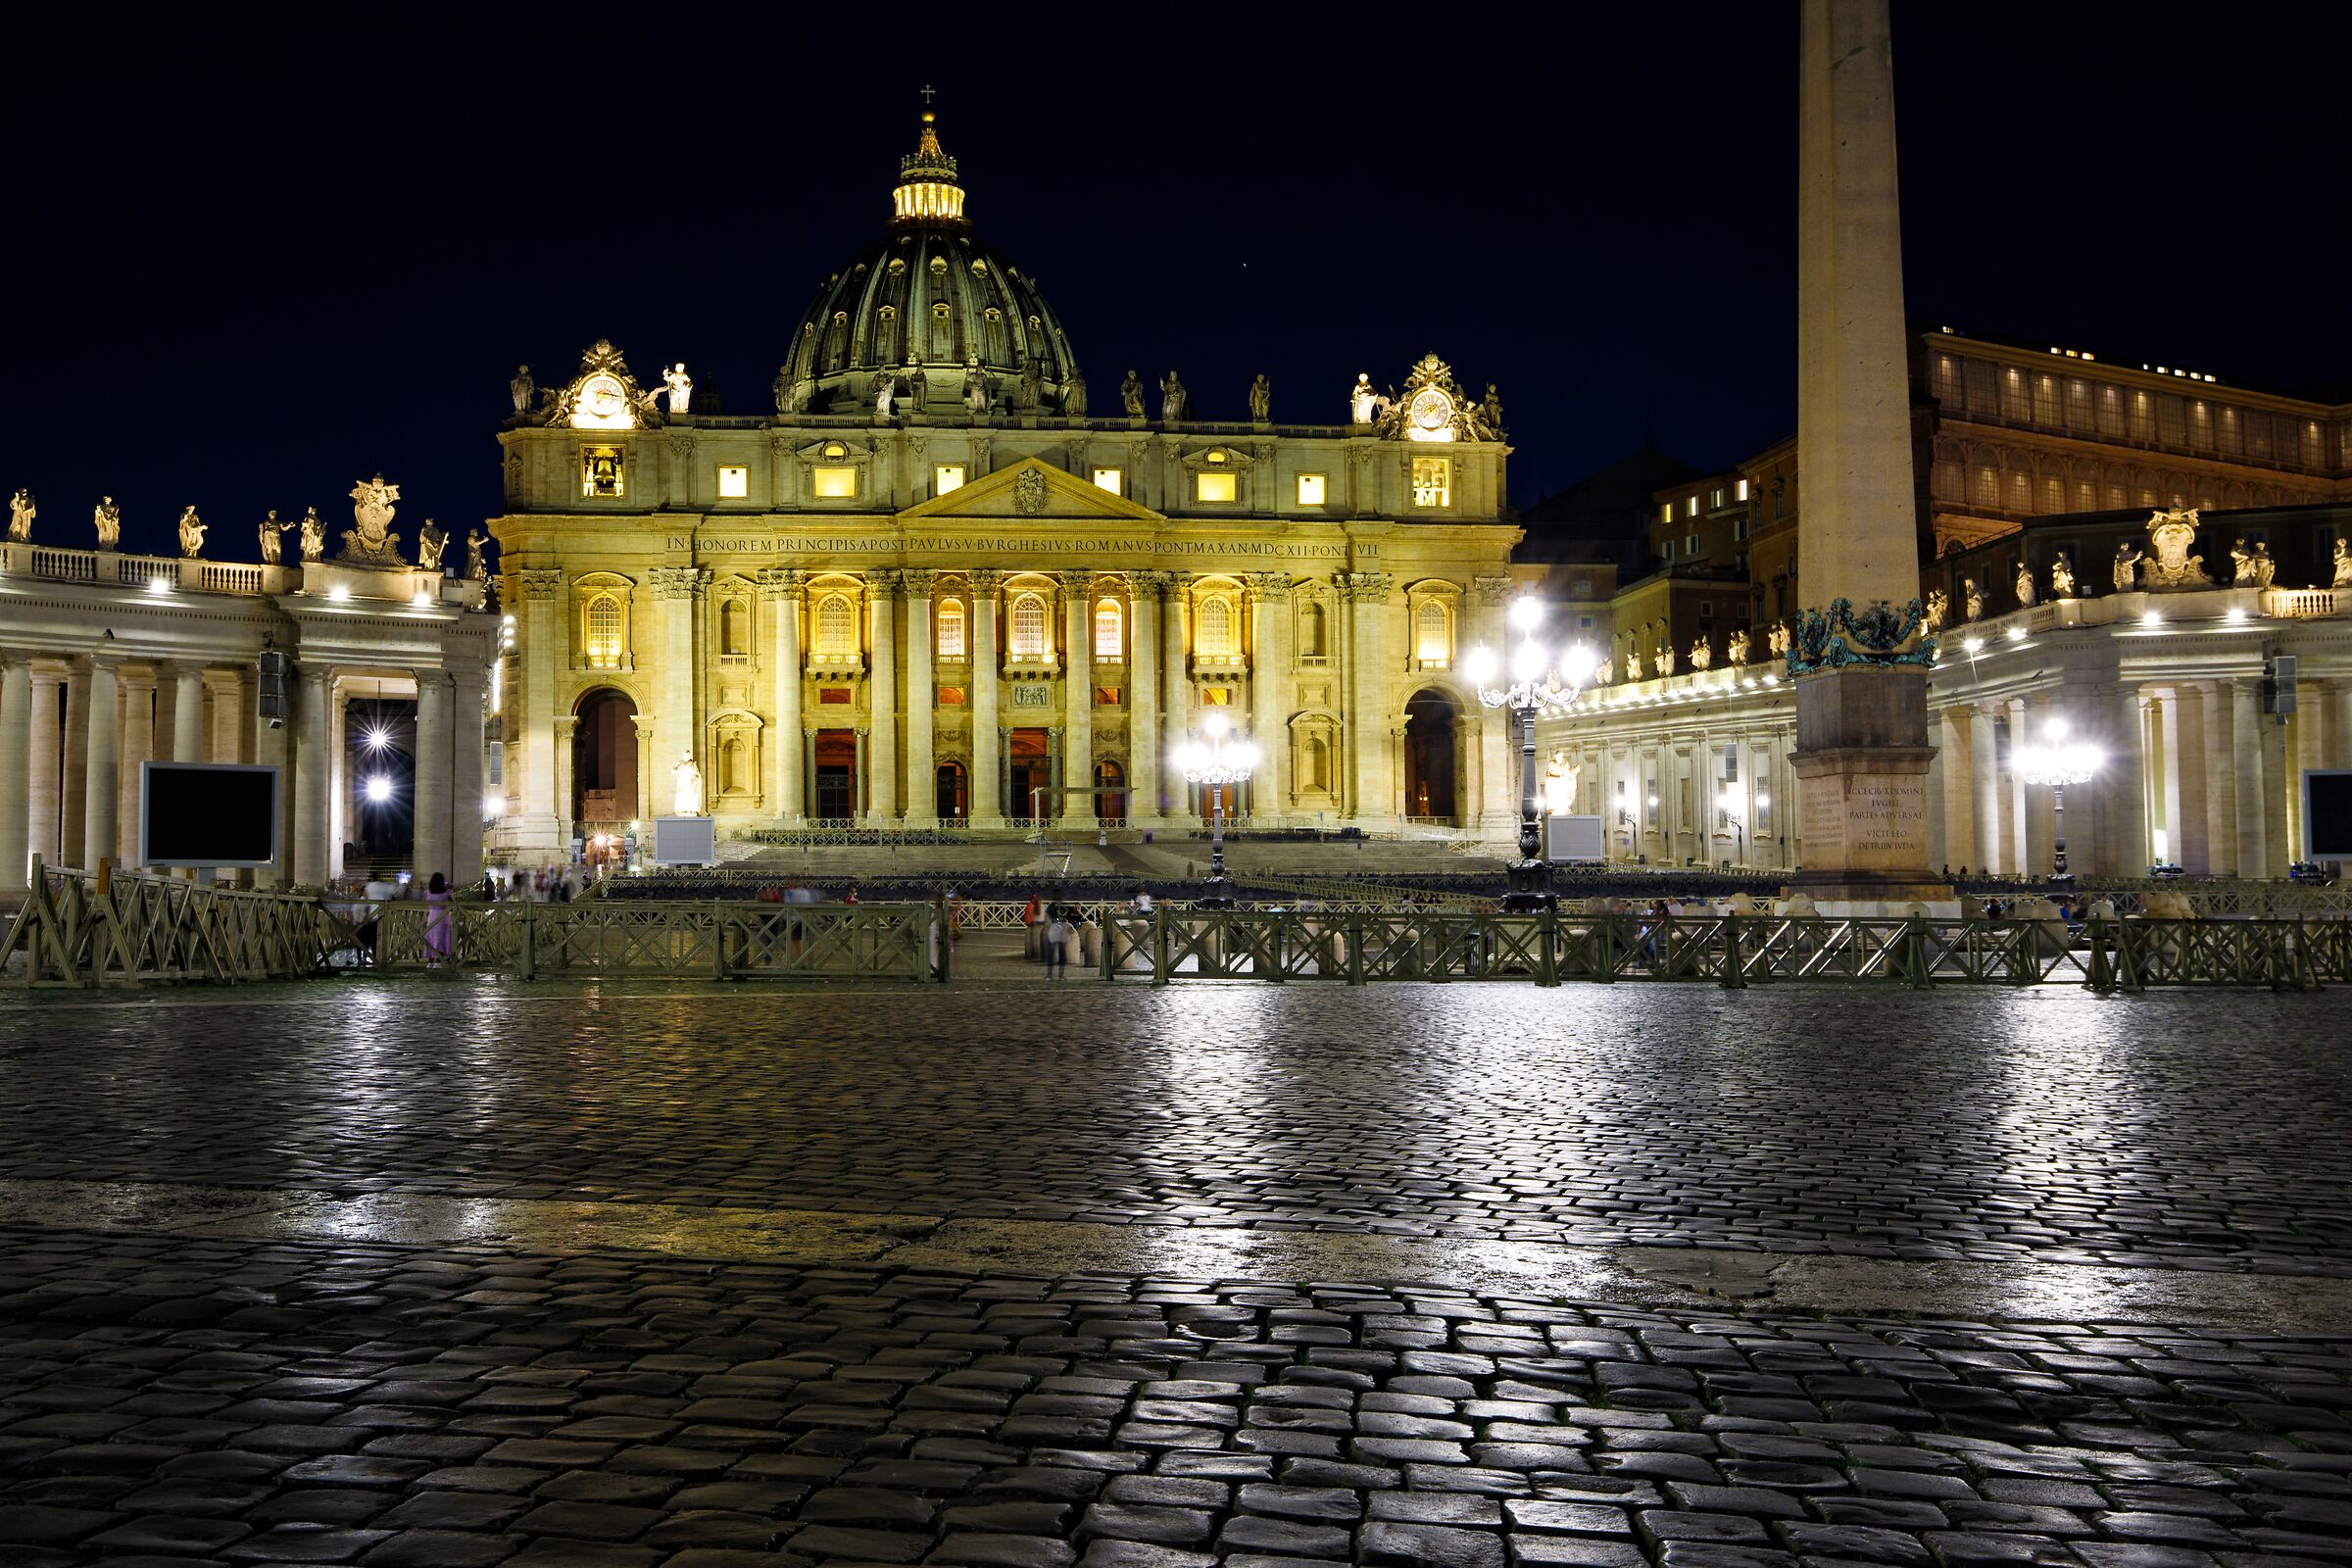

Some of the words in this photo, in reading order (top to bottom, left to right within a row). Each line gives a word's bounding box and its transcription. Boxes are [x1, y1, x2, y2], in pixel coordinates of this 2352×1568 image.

[666, 537, 685, 549] IN
[693, 539, 771, 552] HONOREM
[777, 538, 857, 551] PRINCIPIS
[858, 539, 906, 551] APOST
[909, 538, 961, 550] PAVLVS
[964, 538, 973, 550] V
[977, 539, 1071, 551] BVRGHESIVS
[1075, 540, 1152, 552] ROMANVS
[1154, 542, 1193, 554] PONT
[1193, 542, 1225, 554] MAX
[1227, 543, 1249, 554] AN
[1251, 543, 1307, 556] MDCXII
[1312, 545, 1350, 557] PONT
[1357, 544, 1379, 556] VII
